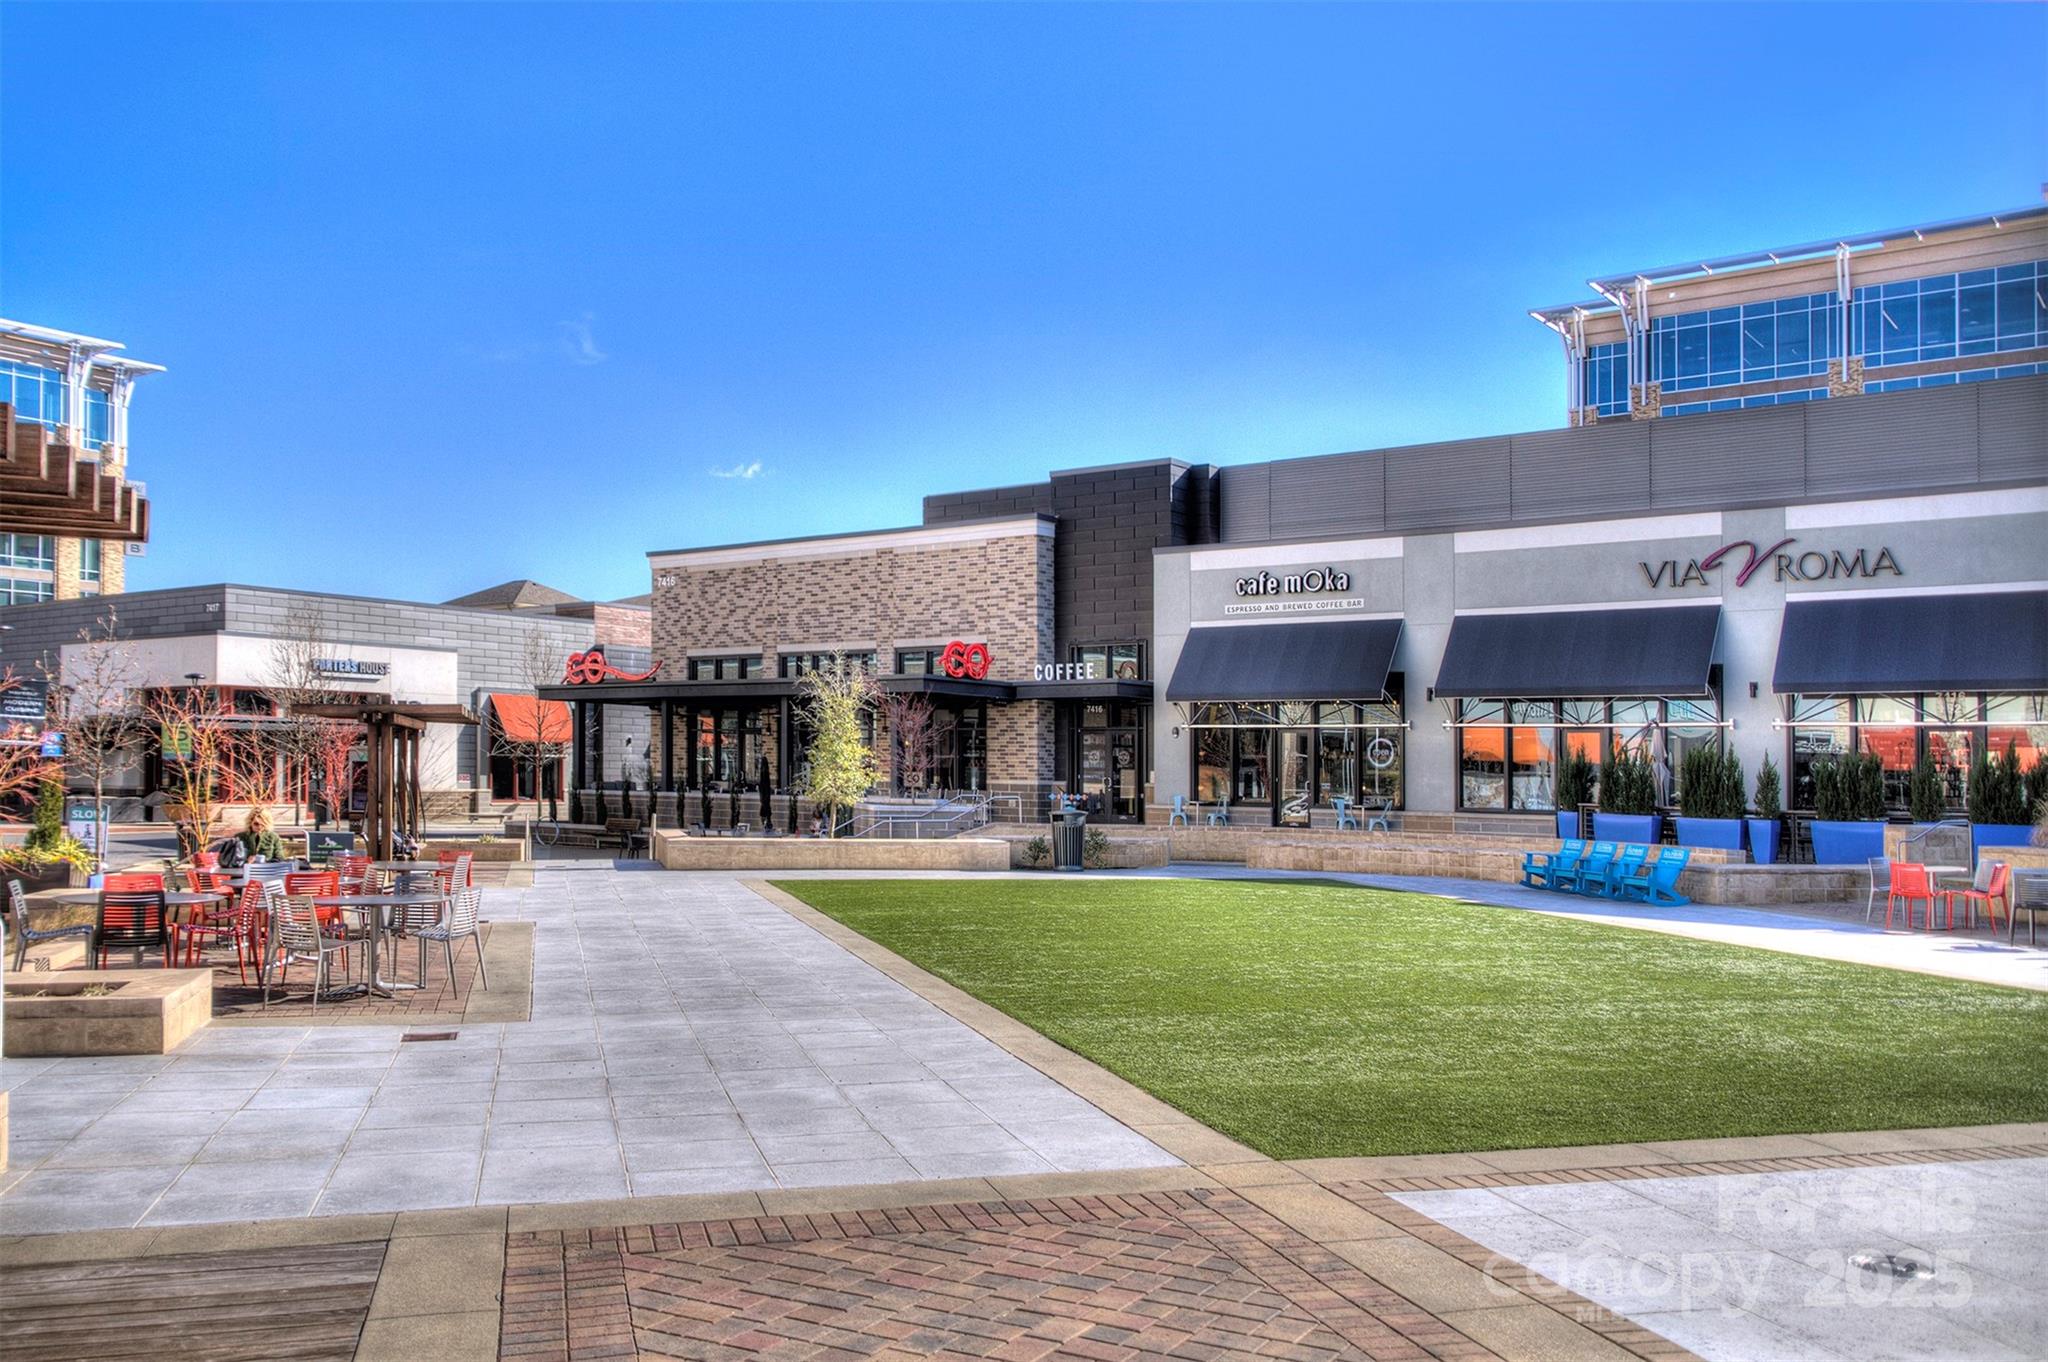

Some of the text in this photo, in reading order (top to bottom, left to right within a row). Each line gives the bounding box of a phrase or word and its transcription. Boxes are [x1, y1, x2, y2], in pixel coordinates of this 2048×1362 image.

[1638, 558, 1708, 588] VIA
[1773, 546, 1902, 583] ROMA
[1235, 570, 1280, 596] cafe
[1226, 605, 1262, 613] ESPRESSO
[1282, 602, 1313, 610] BREWED
[1315, 600, 1344, 609] COFFEE
[1347, 599, 1362, 607] BAR
[360, 662, 391, 675] HOUSE
[1034, 662, 1095, 681] COFFEE
